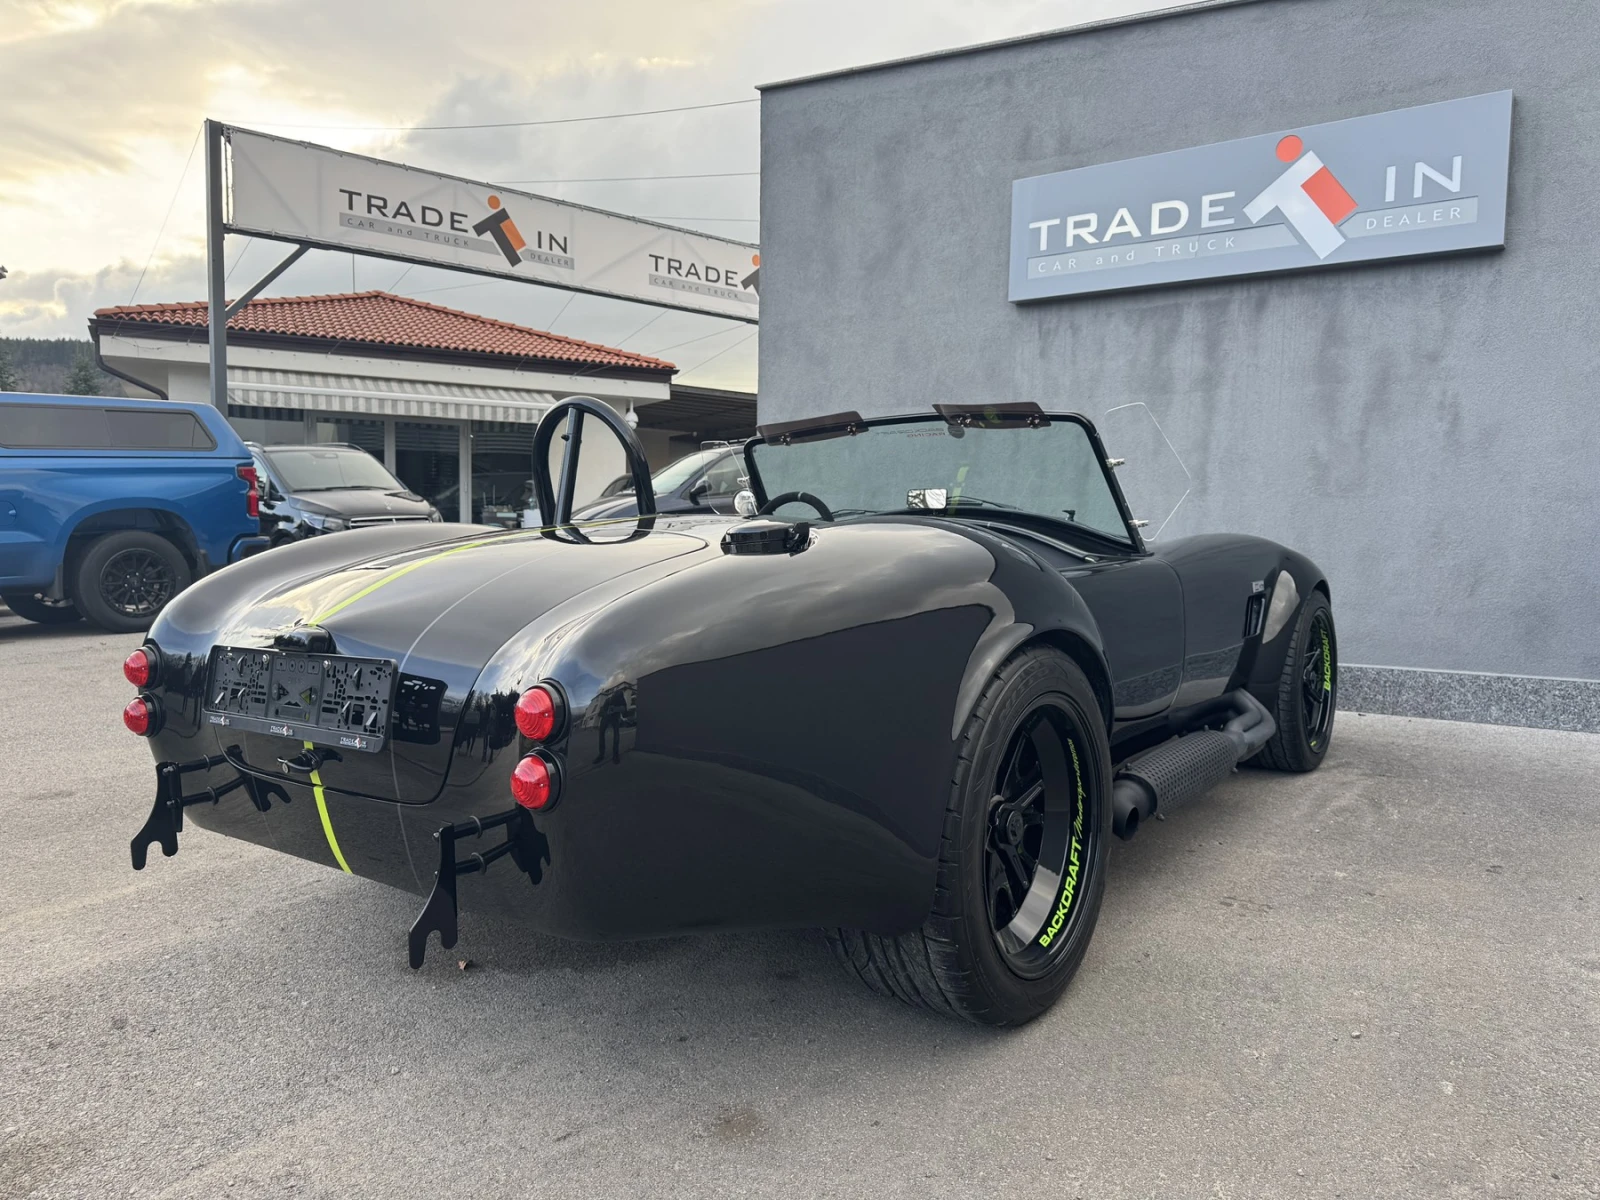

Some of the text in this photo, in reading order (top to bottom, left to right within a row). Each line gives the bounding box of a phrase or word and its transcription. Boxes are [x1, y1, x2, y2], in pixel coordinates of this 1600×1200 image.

[339, 188, 468, 233] TRADE
[537, 231, 567, 254] IN
[1029, 191, 1235, 251] TRADE
[1385, 155, 1462, 202] IN
[347, 218, 569, 266] CAR and TRUCK DEALER
[649, 254, 738, 288] TRADE
[1038, 207, 1460, 273] CAR and TRUCK DEALER
[654, 278, 739, 299] CAR and TRUCK
[1320, 629, 1331, 691] BACKDRAFT
[1039, 836, 1082, 947] BACKDRAFT
